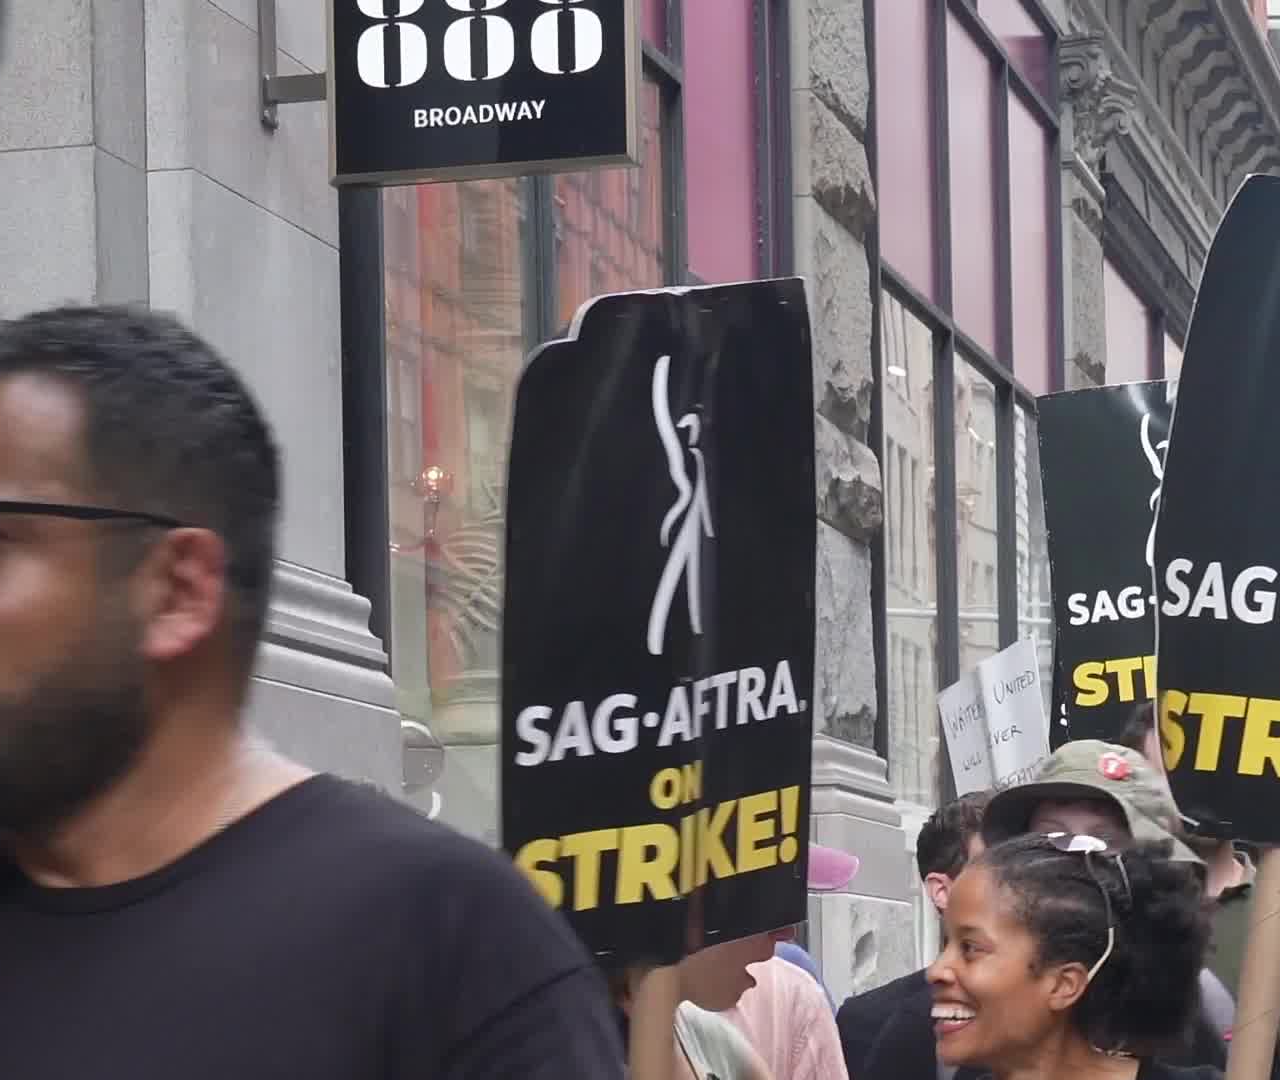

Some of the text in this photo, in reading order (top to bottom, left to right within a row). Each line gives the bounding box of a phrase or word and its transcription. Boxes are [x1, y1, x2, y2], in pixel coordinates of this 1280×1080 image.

[414, 100, 546, 128] BROADWAY
[993, 670, 1035, 704] UNITED
[649, 760, 703, 810] ON
[514, 785, 800, 912] STRIKE!
